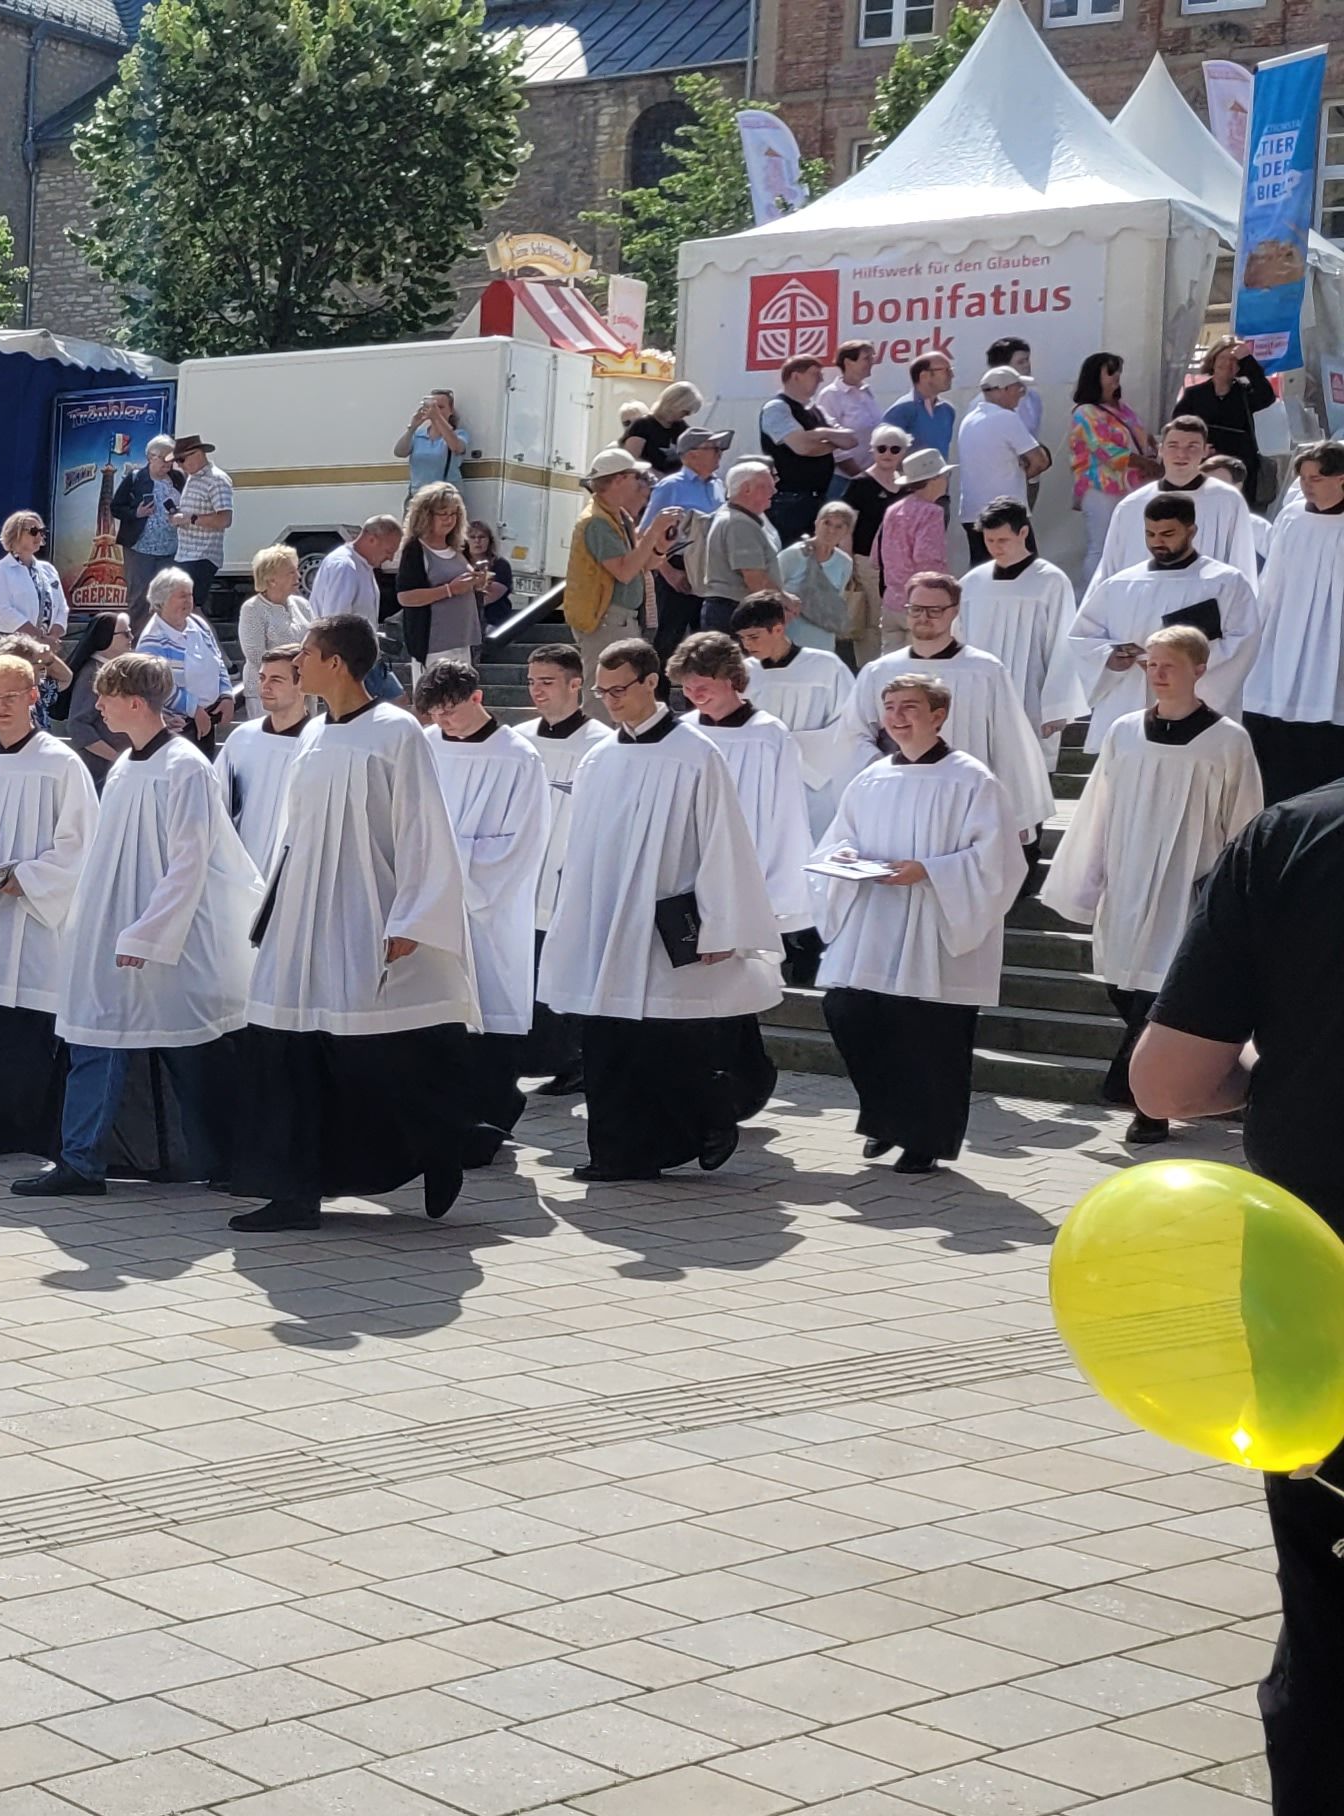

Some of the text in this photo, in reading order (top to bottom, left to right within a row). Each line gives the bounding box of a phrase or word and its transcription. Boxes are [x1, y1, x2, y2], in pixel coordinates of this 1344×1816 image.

[852, 255, 1050, 279] Hilfswerk für den Glauben
[852, 279, 1072, 325] bonifatius
